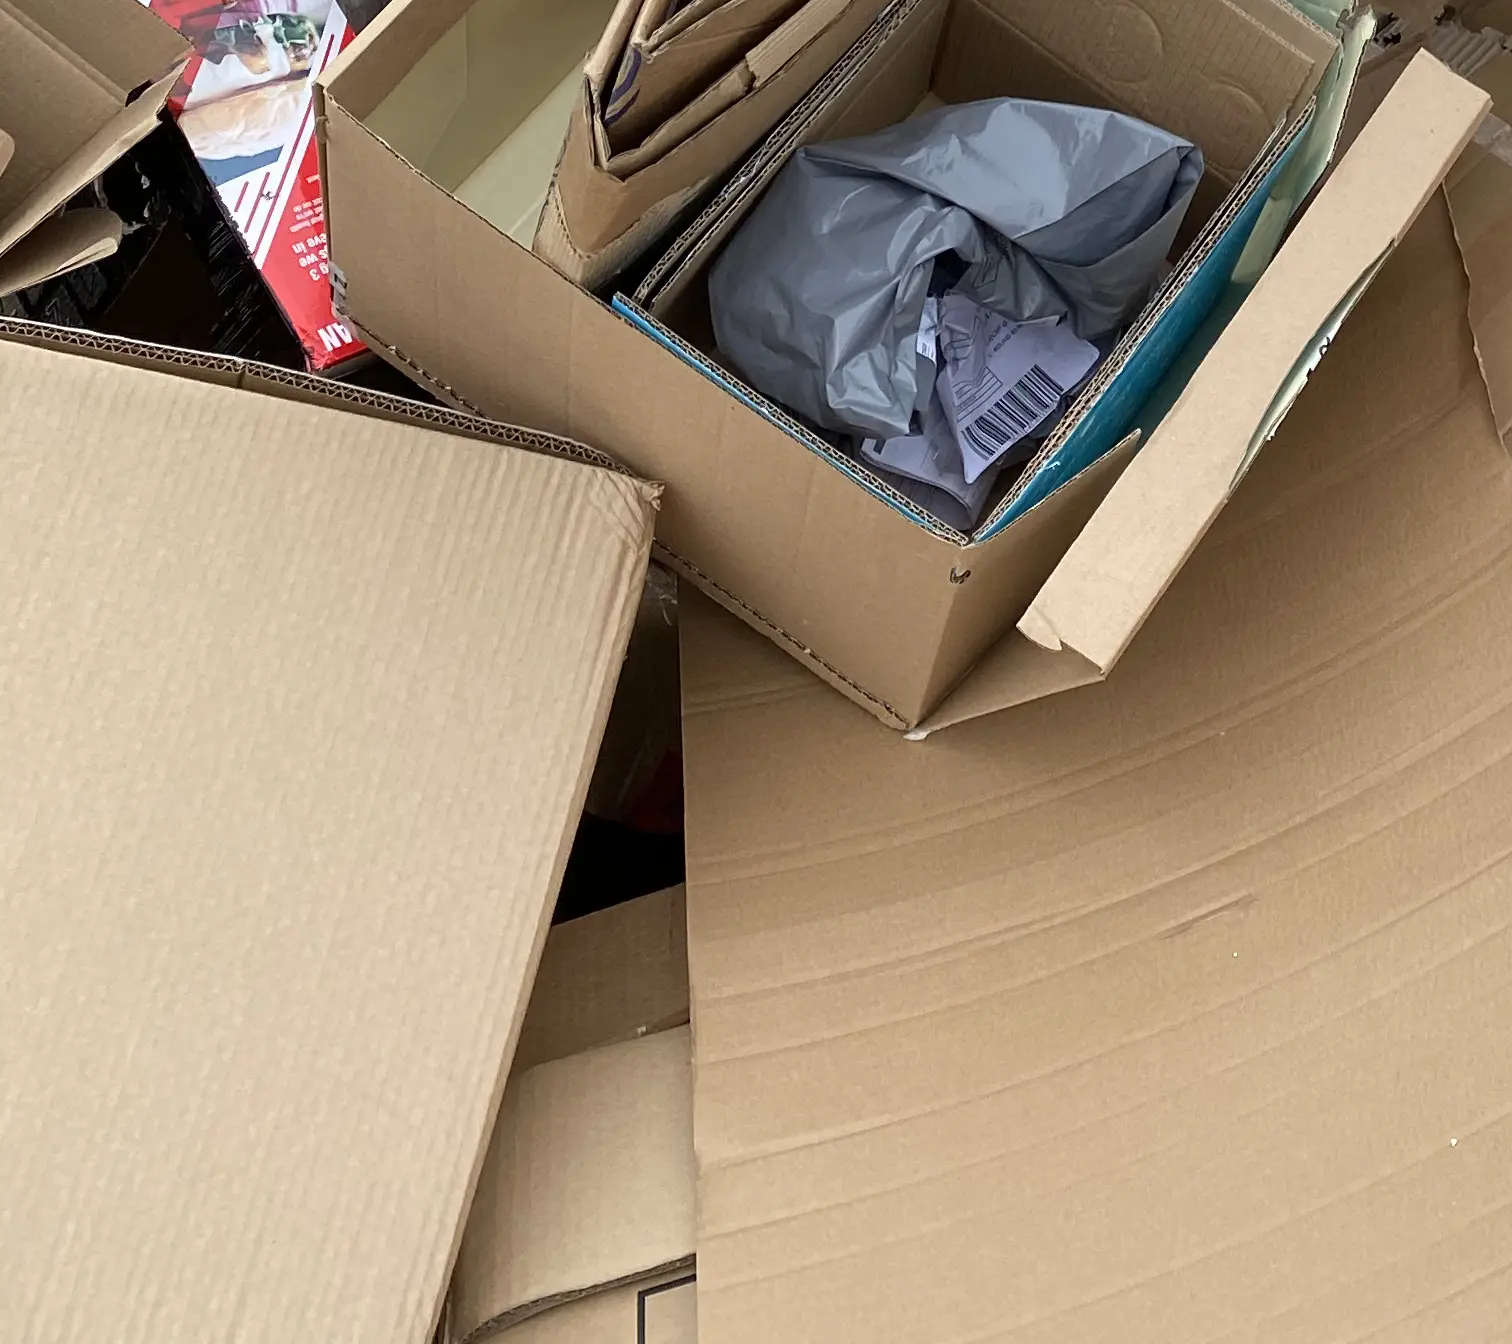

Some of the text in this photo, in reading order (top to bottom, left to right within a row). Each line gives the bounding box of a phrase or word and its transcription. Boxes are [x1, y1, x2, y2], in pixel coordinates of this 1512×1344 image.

[291, 241, 307, 254] in
[298, 253, 318, 268] we
[309, 268, 321, 282] 3
